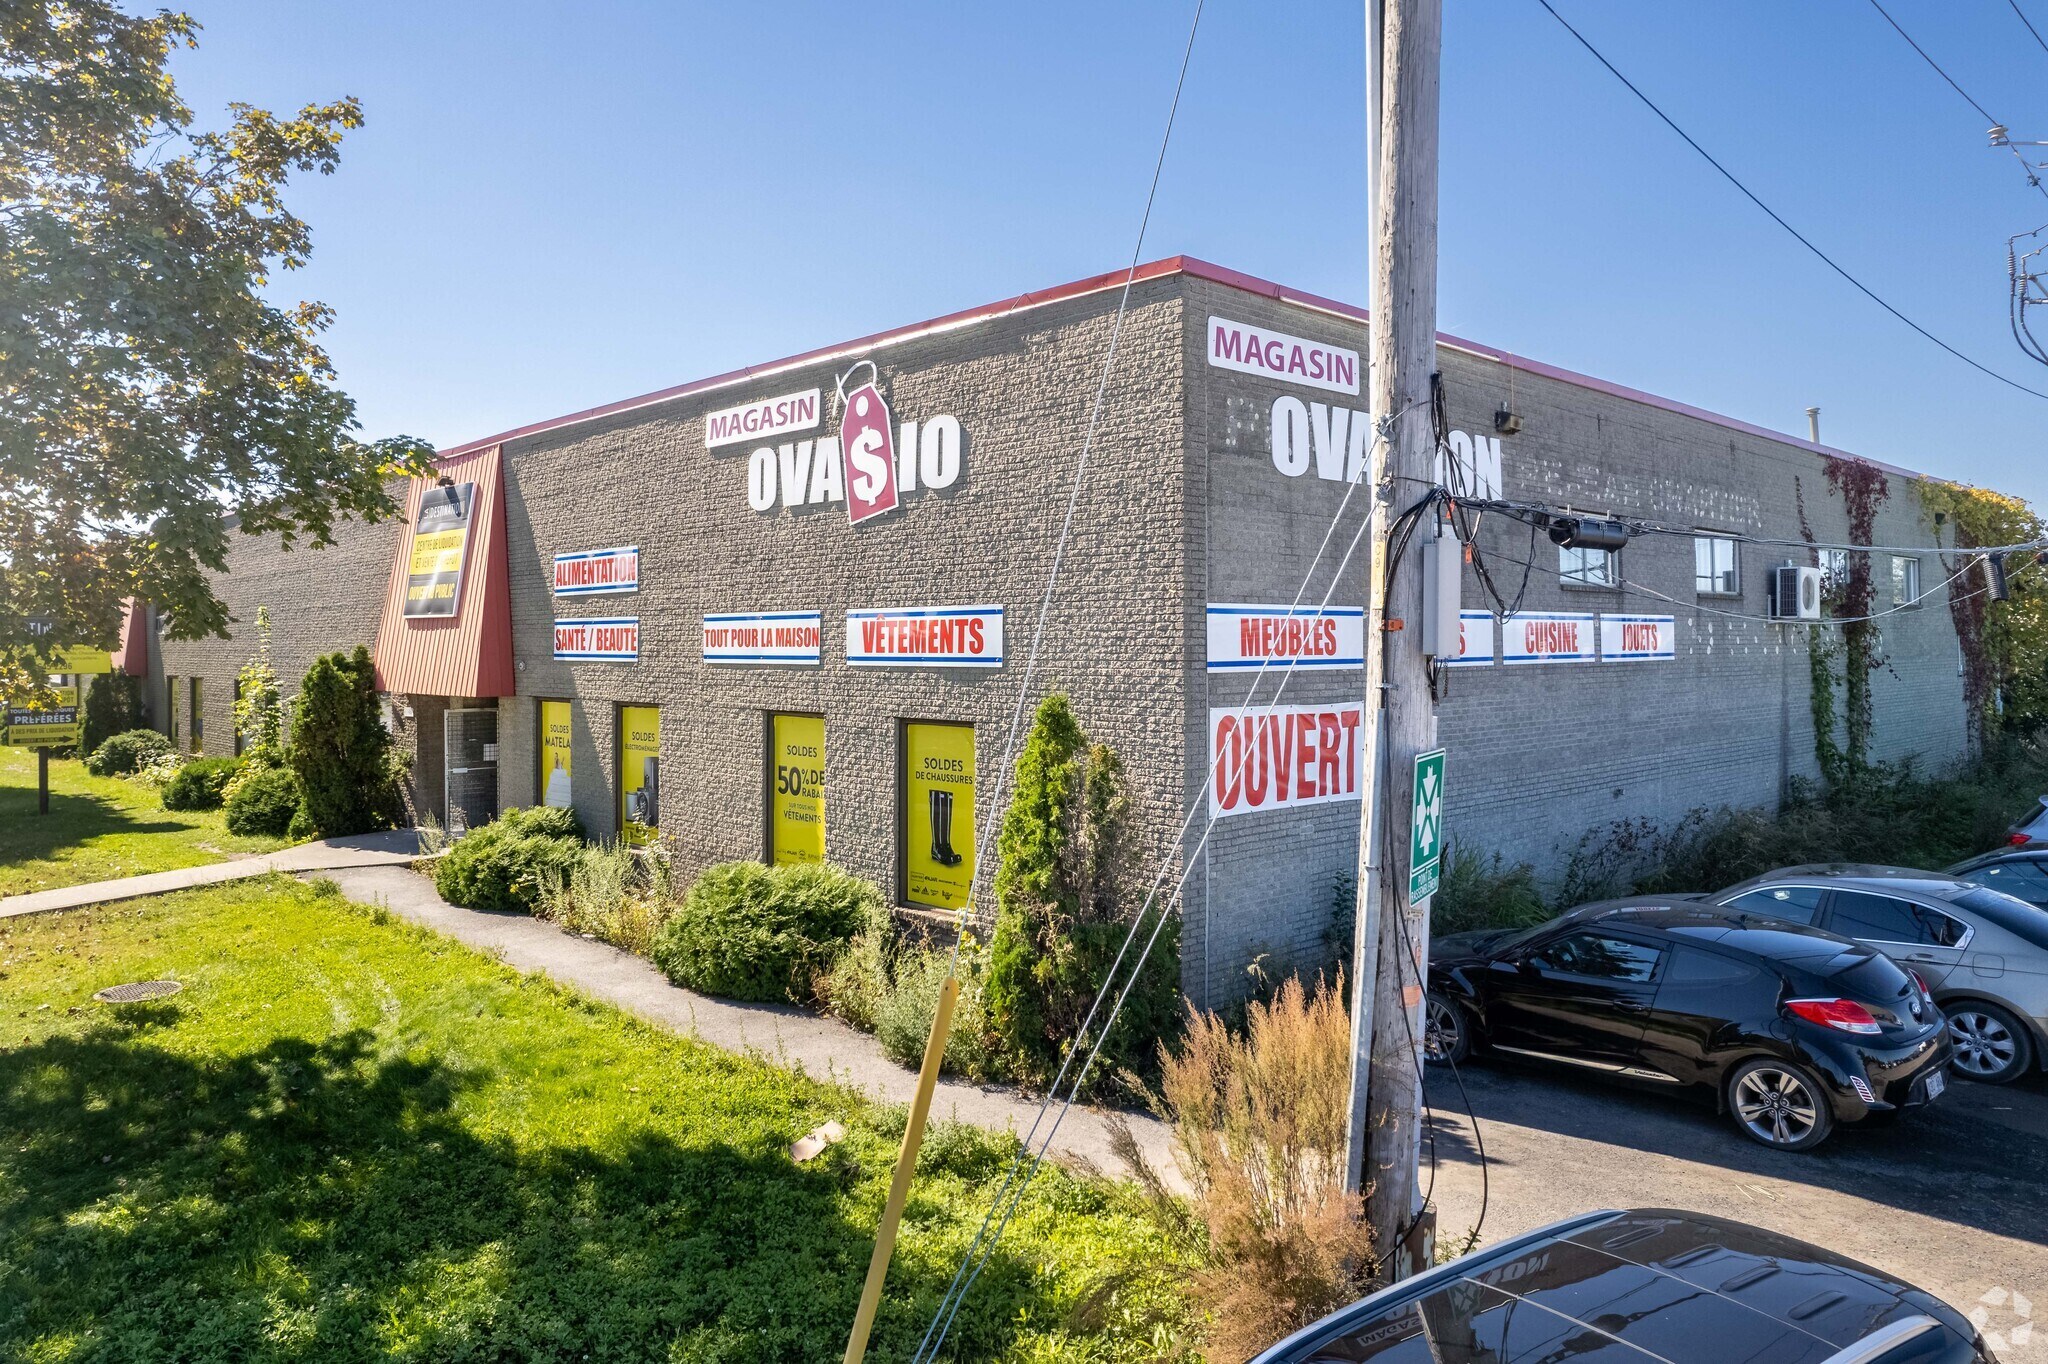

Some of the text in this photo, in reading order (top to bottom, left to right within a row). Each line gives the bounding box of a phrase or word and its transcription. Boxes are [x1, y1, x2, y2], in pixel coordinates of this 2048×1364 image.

[1214, 326, 1354, 386] MAGASIN
[710, 396, 815, 441] MAGASIN
[556, 556, 636, 587] ALIMENTATION
[555, 624, 637, 651] SANTÉ / BEAUTÉ
[705, 627, 819, 648] TOUT POUR LA MAISON
[862, 613, 985, 655] VÊTEMENTS
[1240, 618, 1337, 657] MEUBLES
[1525, 621, 1579, 654] CUISINE
[1622, 624, 1658, 651] JOUETS
[550, 724, 569, 734] SOLDES
[632, 731, 655, 742] SOLDES
[787, 745, 817, 757] SOLDES
[924, 757, 963, 772] SOLDES
[1215, 710, 1360, 810] OUVERT
[916, 771, 973, 785] DE CHAUSSURES
[784, 809, 822, 824] VÊTEMENTS
